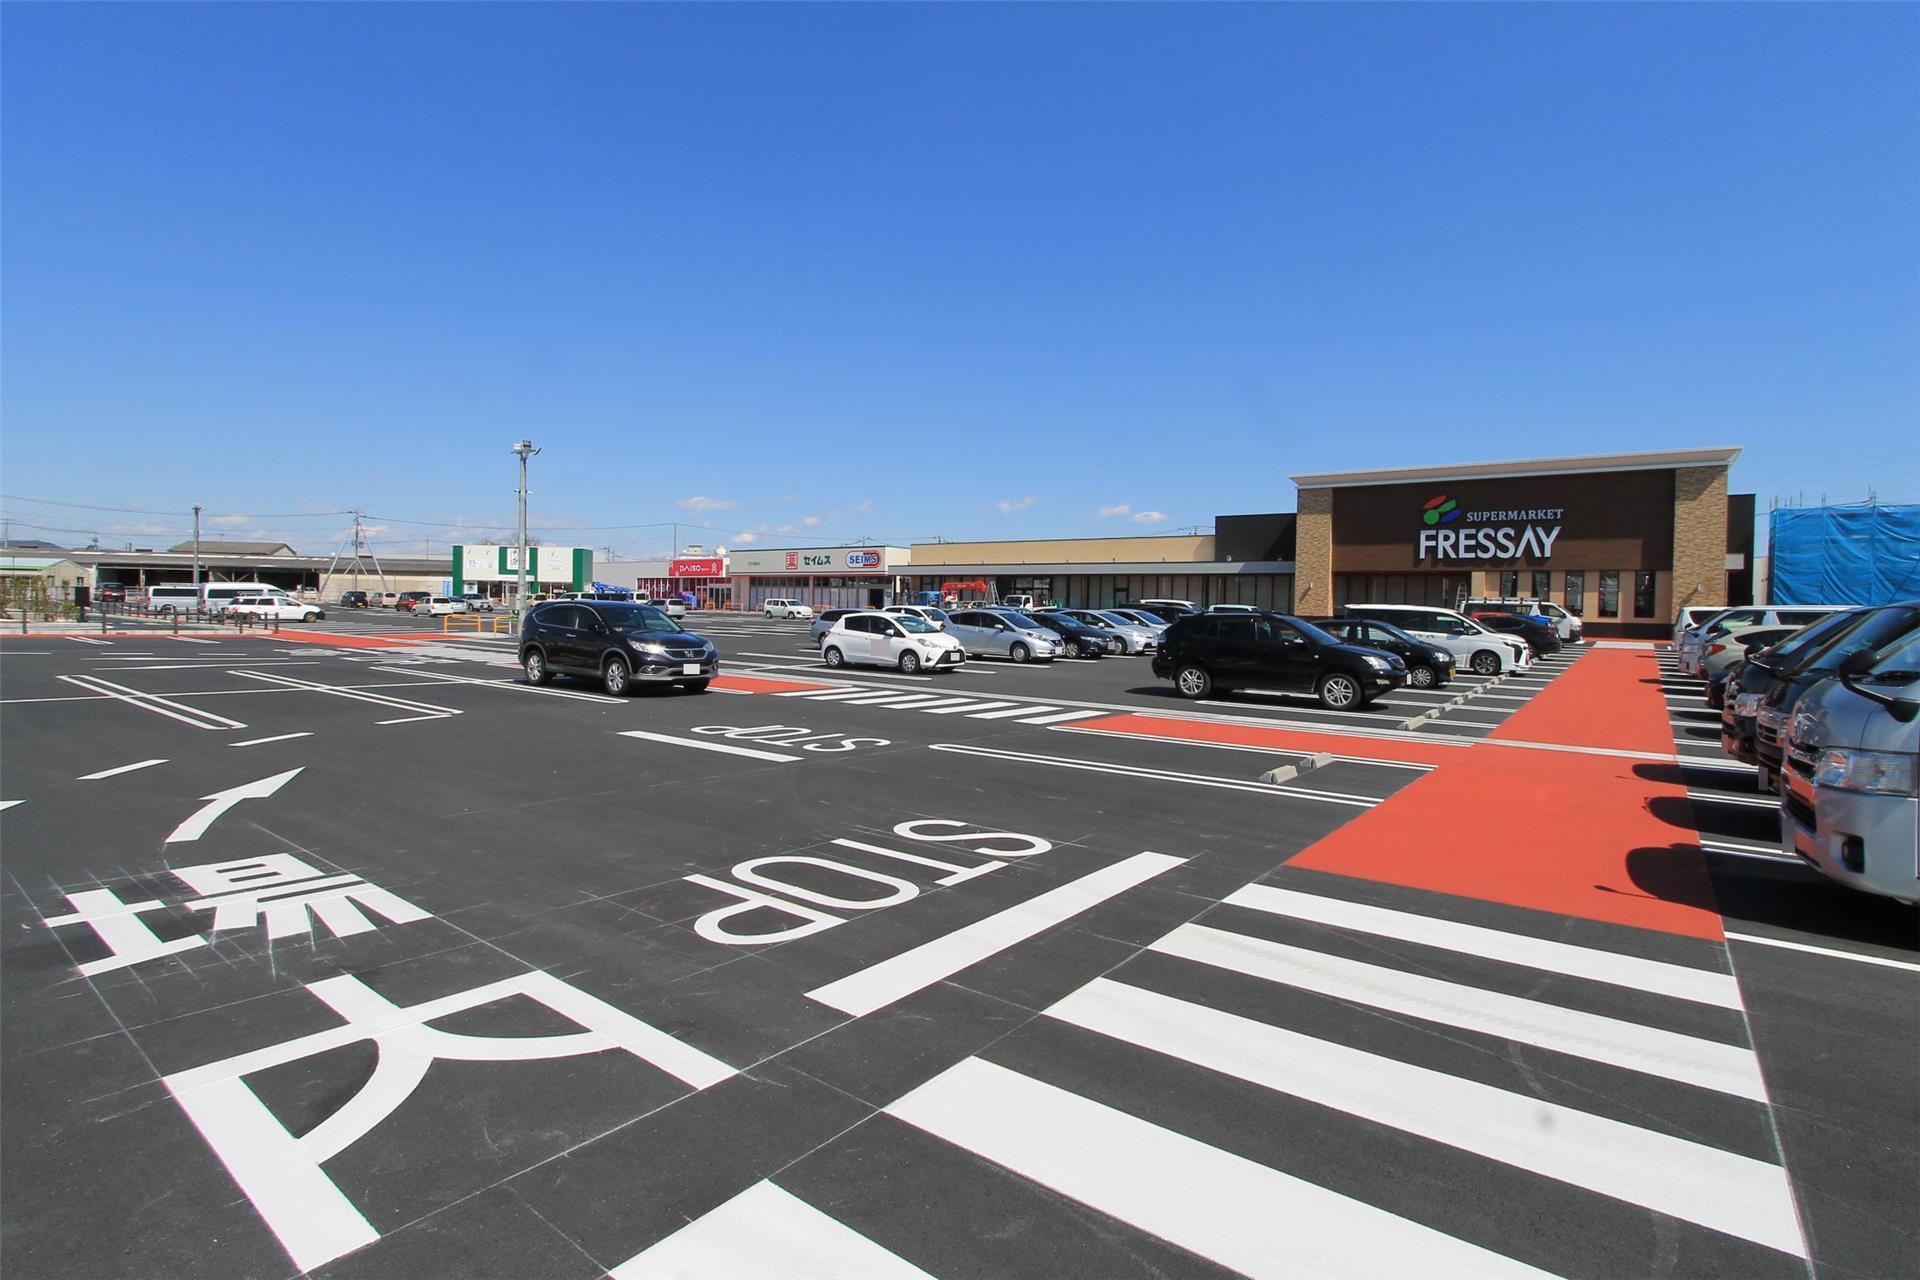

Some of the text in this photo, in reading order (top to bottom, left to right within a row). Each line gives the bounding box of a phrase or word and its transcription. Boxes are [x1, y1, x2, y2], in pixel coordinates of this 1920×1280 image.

[1466, 508, 1564, 522] SUPERMARKET
[1419, 523, 1562, 560] FRESSAY
[803, 555, 832, 566] セイムス
[849, 554, 878, 565] SEIMS
[679, 564, 702, 573] DAISO
[690, 724, 891, 752] STOP
[683, 819, 1053, 945] STOP
